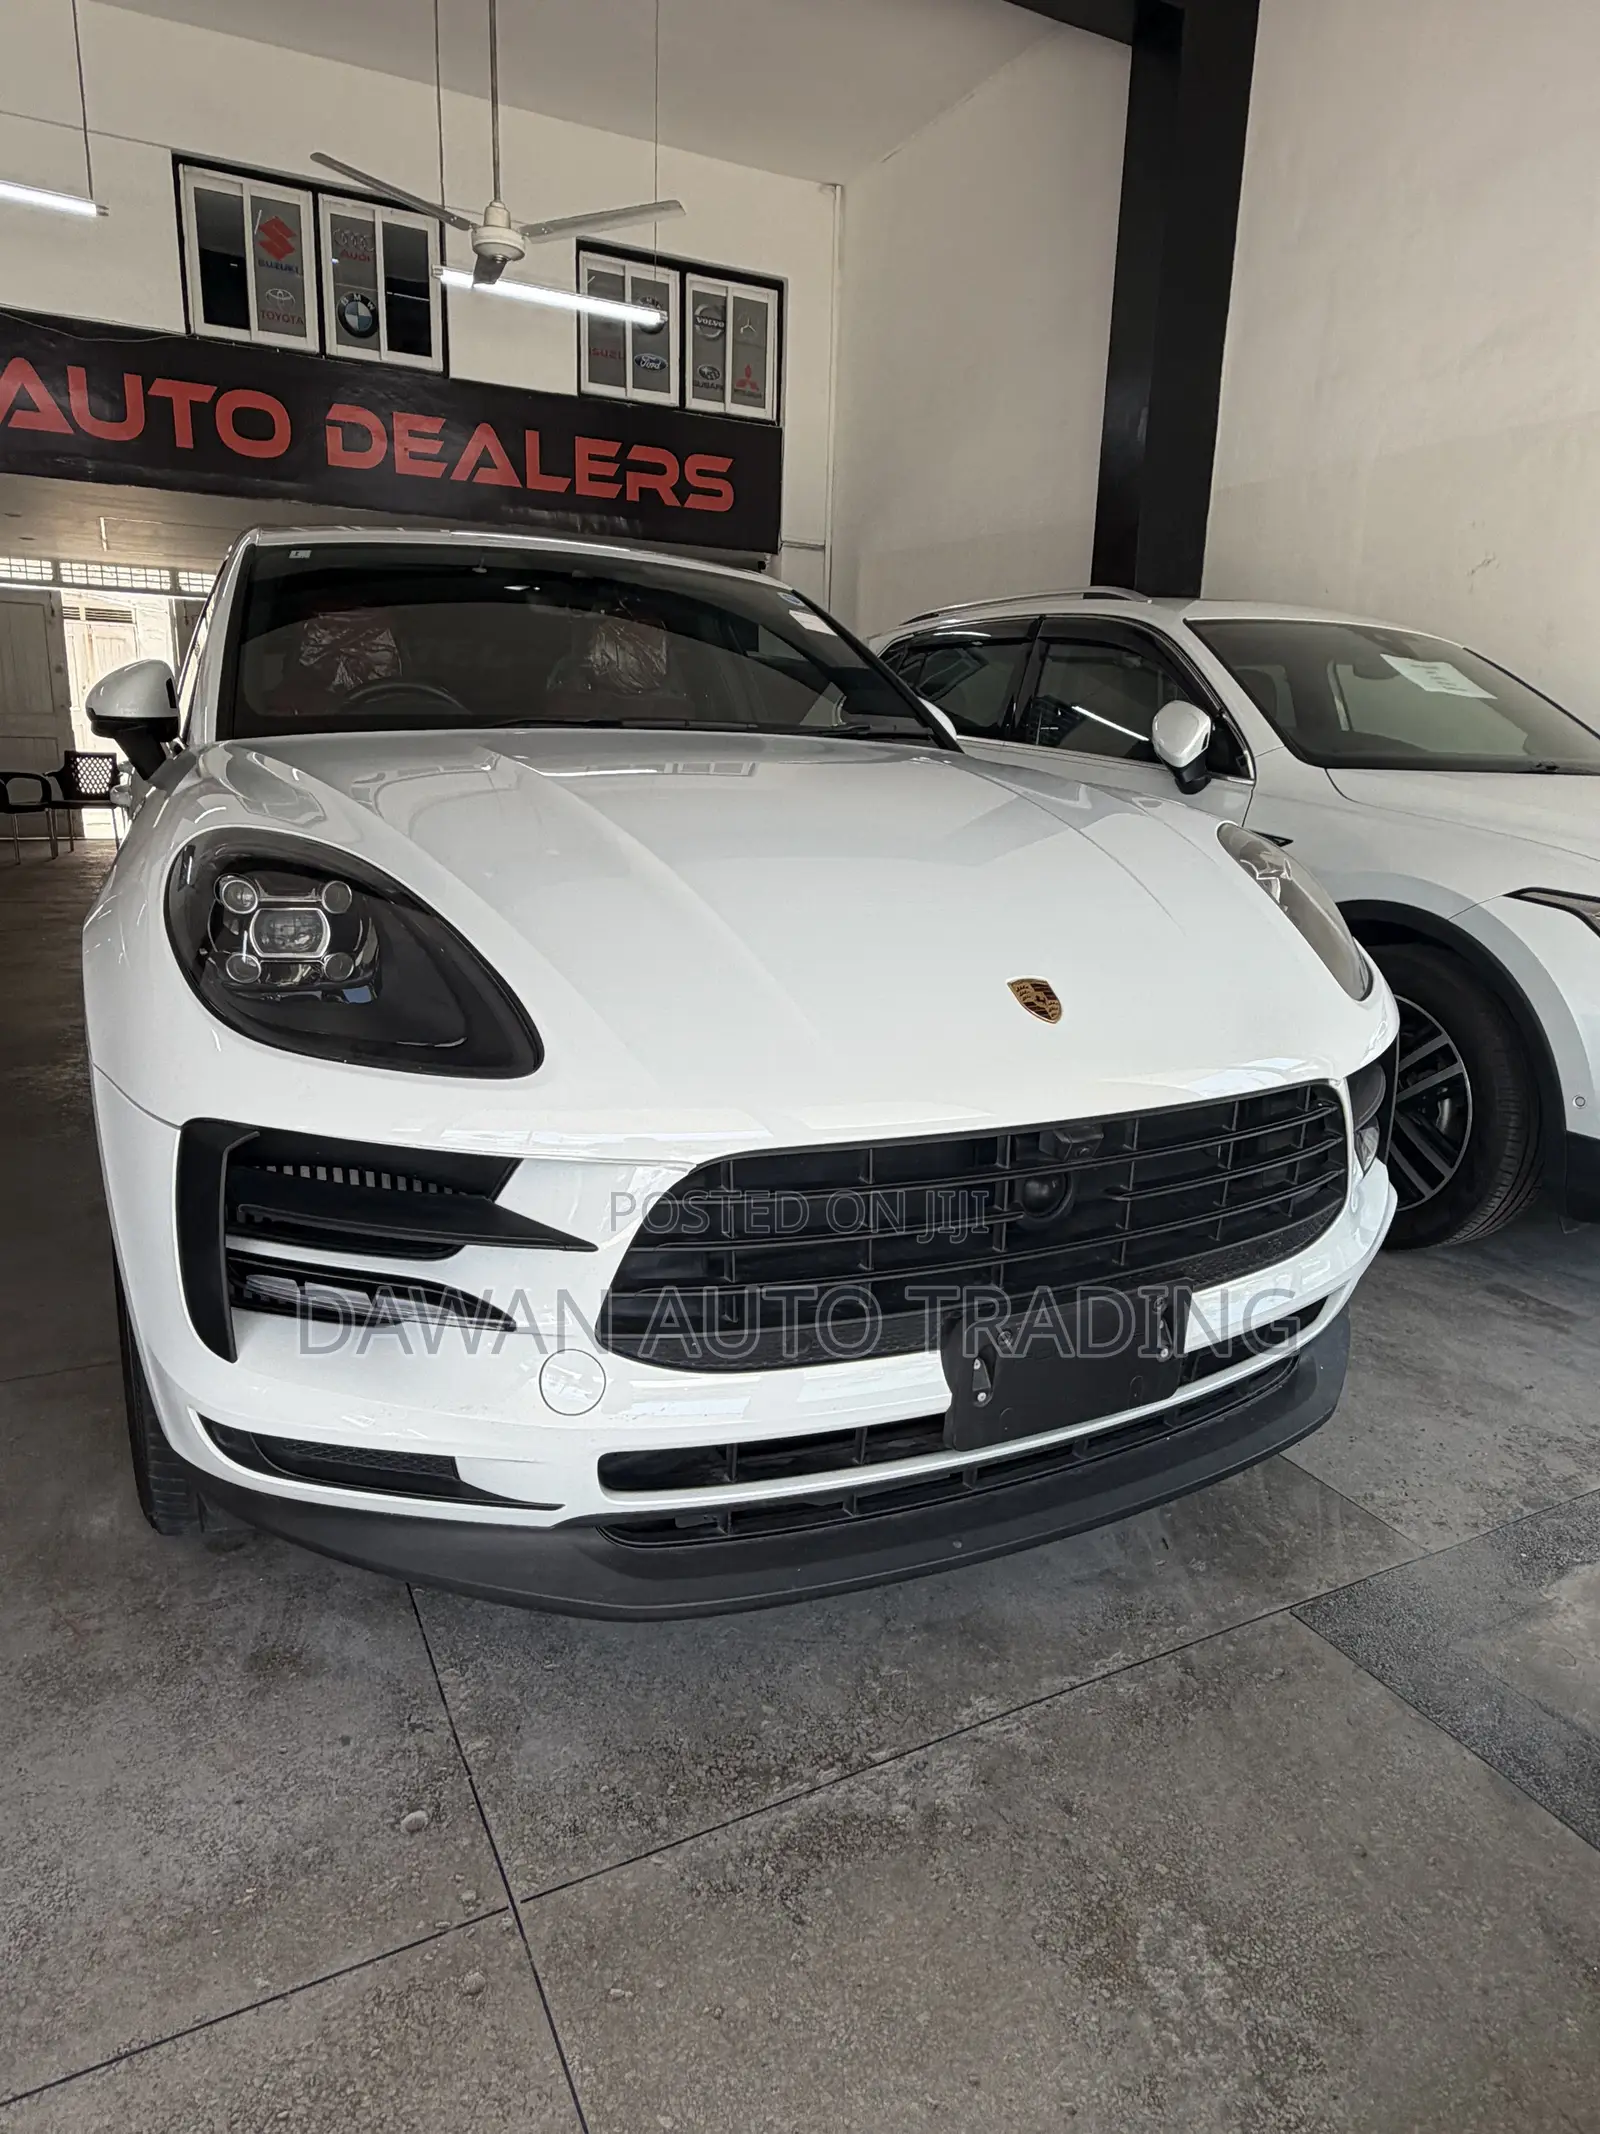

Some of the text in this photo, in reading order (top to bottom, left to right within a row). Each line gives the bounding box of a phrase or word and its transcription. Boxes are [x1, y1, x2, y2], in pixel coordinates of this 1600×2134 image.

[260, 310, 304, 325] TOYOTA
[696, 316, 725, 328] VOLVO
[0, 357, 734, 512] AUTO DEALERS
